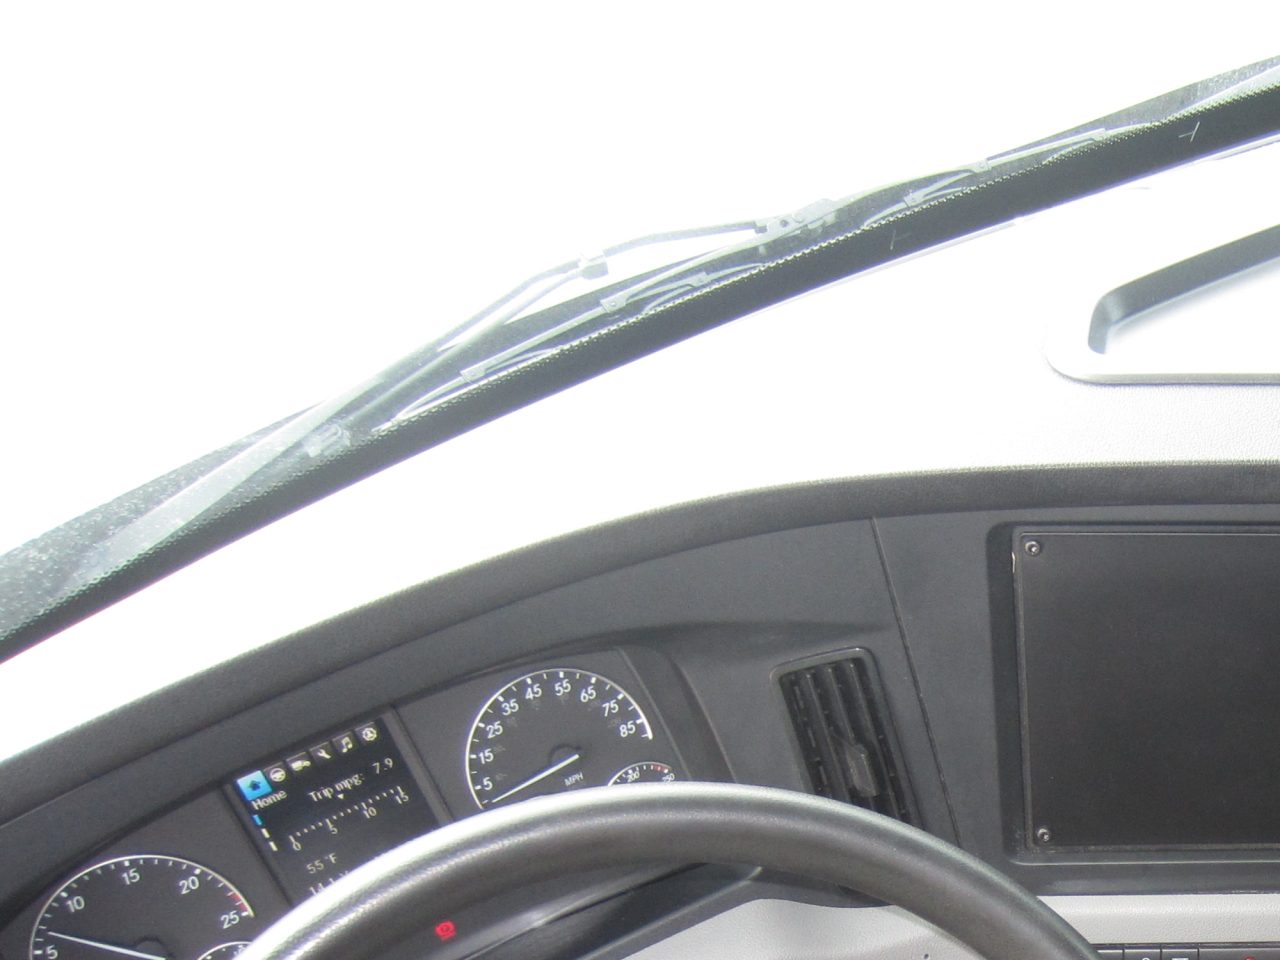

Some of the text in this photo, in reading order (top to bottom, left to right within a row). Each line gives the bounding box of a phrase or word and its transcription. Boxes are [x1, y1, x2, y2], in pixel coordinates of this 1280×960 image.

[525, 684, 542, 700] 45
[554, 679, 571, 696] 55
[580, 686, 597, 703] 65
[501, 699, 519, 716] 35
[602, 700, 619, 717] 75
[486, 721, 504, 739] 25
[619, 721, 636, 738] 85
[479, 749, 494, 764] 15
[308, 758, 394, 803] Trip mpg: 7.9
[483, 777, 493, 790] 5
[564, 772, 584, 787] MPH
[251, 789, 288, 811] Home
[306, 860, 324, 874] 55
[122, 868, 140, 885] 15
[179, 876, 199, 894] 20
[66, 896, 85, 913] 10
[221, 911, 240, 929] 25
[46, 945, 58, 960] 5
